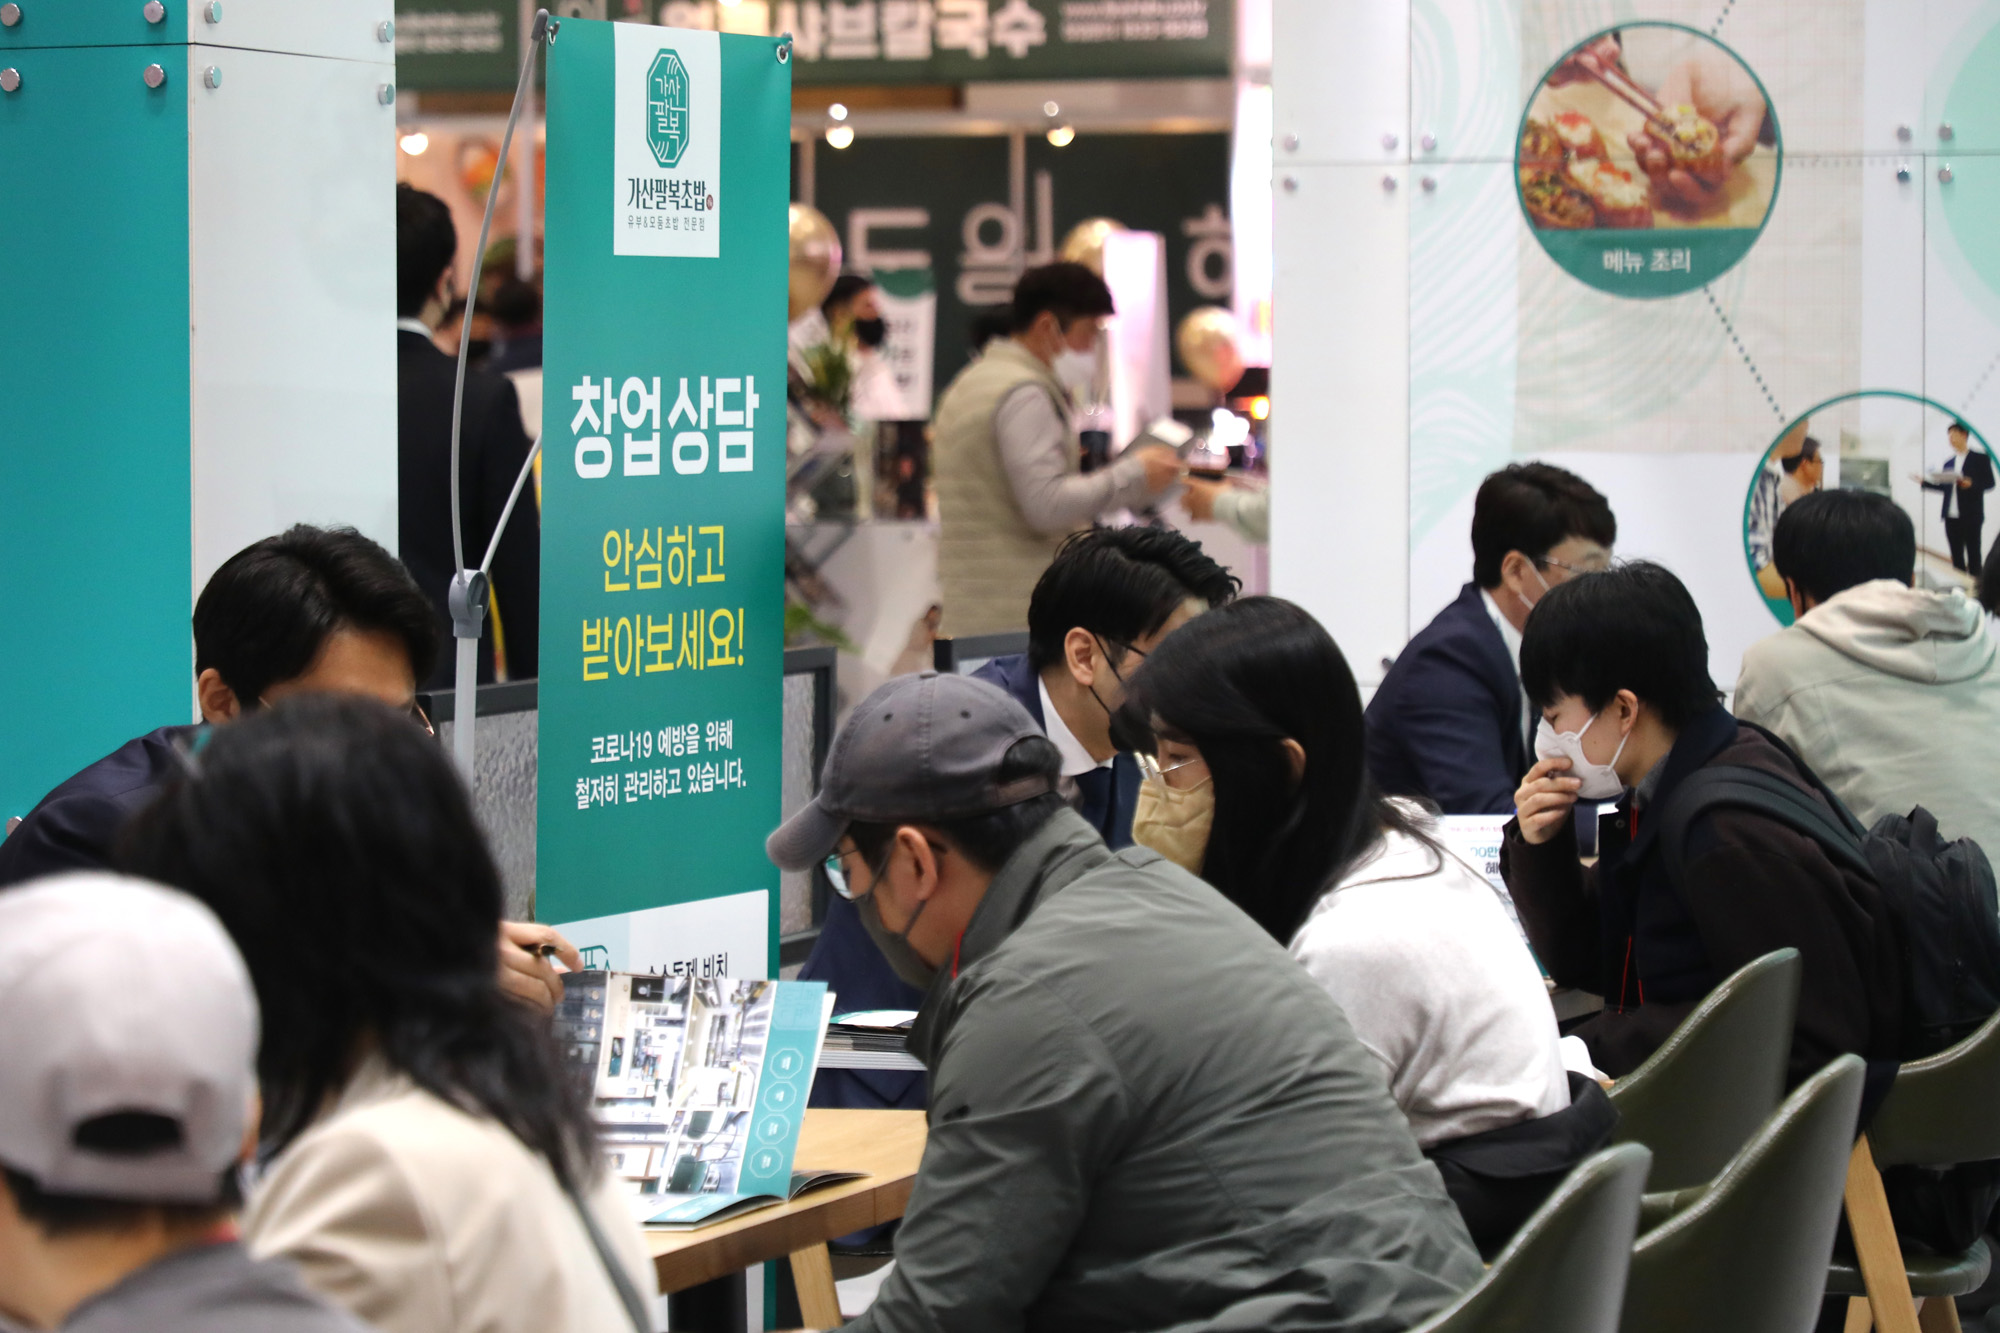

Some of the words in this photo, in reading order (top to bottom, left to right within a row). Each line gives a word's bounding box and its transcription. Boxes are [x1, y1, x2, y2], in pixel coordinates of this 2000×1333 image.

[627, 177, 706, 212] 가산팔복초밥
[684, 217, 705, 232] 전문점
[1602, 247, 1645, 275] 메뉴
[1649, 246, 1691, 274] 조리
[570, 375, 760, 479] 창업상담
[602, 525, 726, 592] 안심하고
[582, 607, 744, 682] 받아보세요!
[590, 730, 653, 764] 코로나19
[657, 722, 700, 758] 예방을
[705, 719, 733, 752] 위해
[575, 773, 619, 810] 철저히
[624, 767, 682, 803] 관리하고
[686, 757, 747, 795] 있습니다.
[703, 951, 728, 979] 비치
